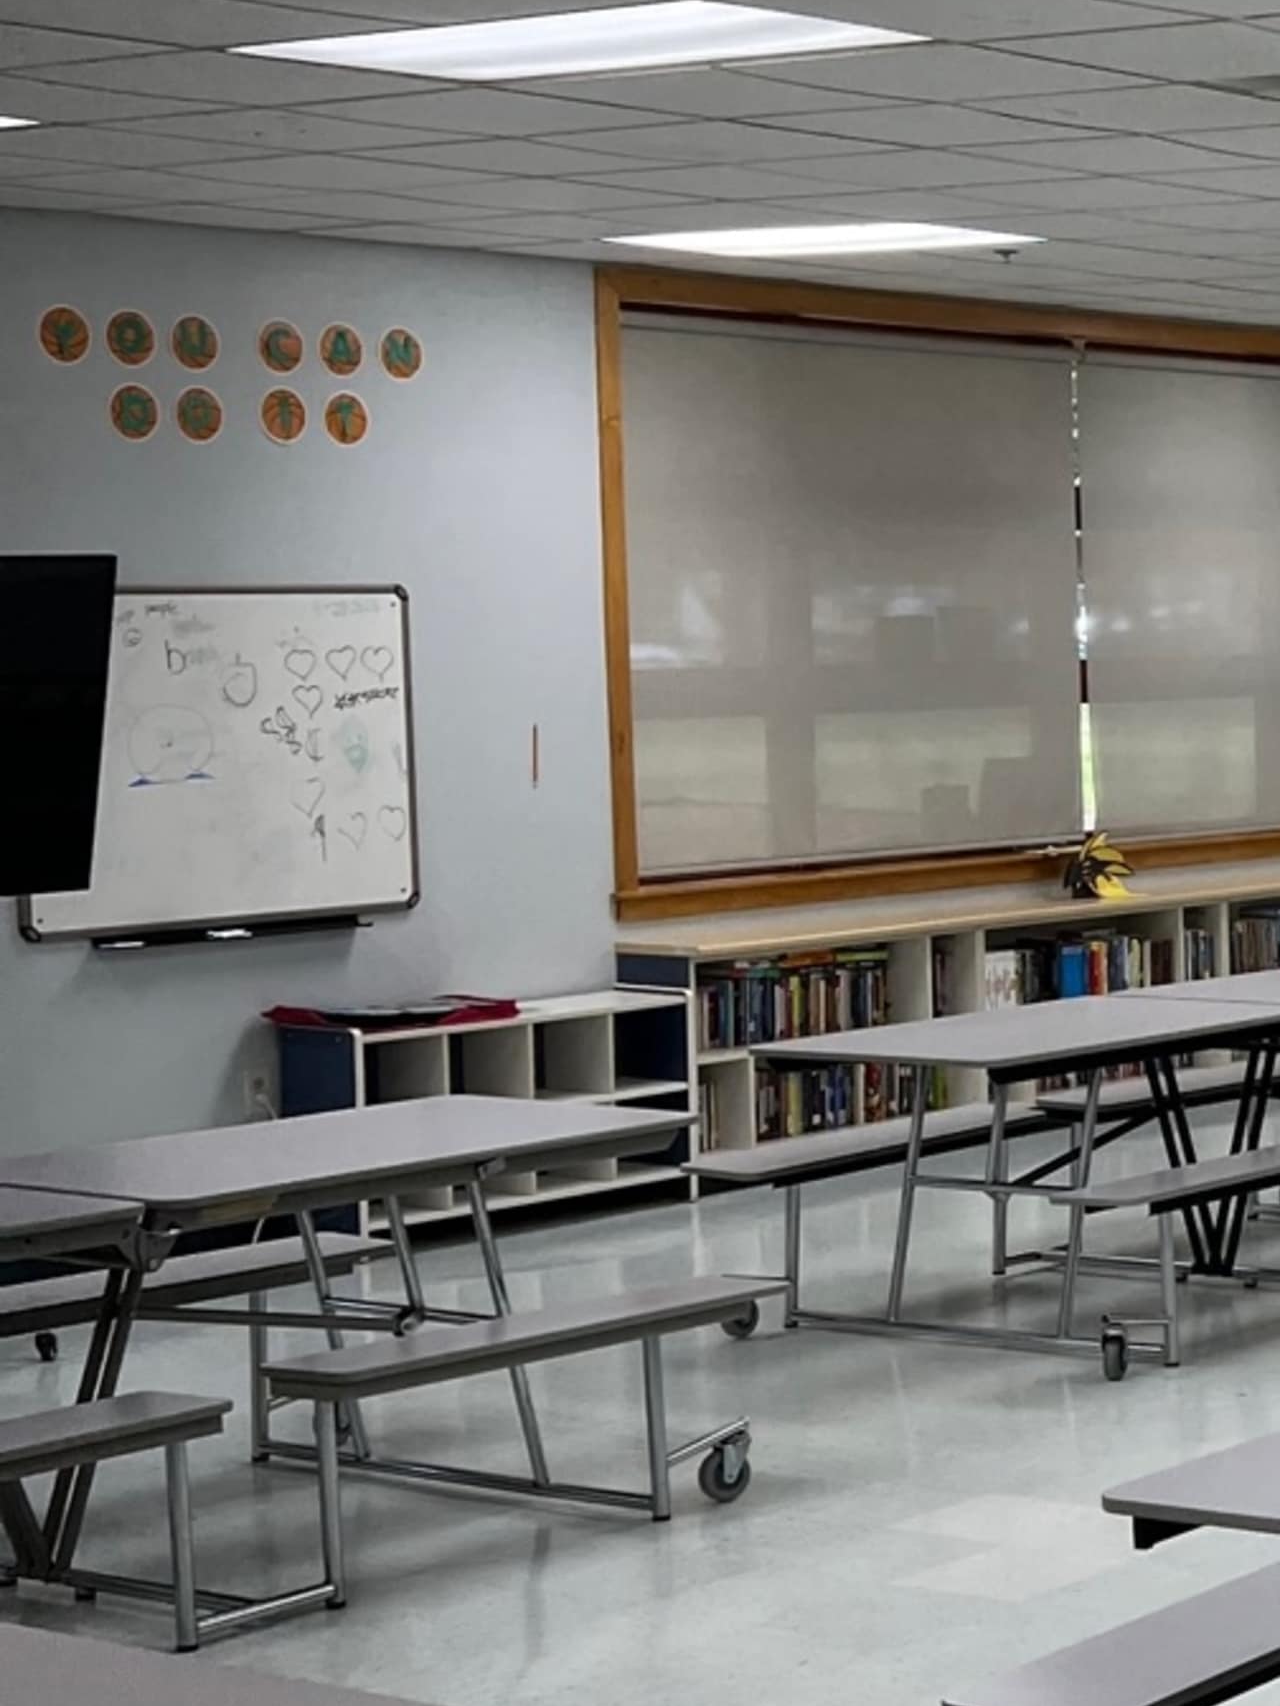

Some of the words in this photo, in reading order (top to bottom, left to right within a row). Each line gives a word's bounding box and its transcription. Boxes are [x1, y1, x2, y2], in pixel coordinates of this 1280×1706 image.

[48, 314, 214, 360] YOU
[263, 324, 414, 367] CAN
[120, 391, 215, 435] DO
